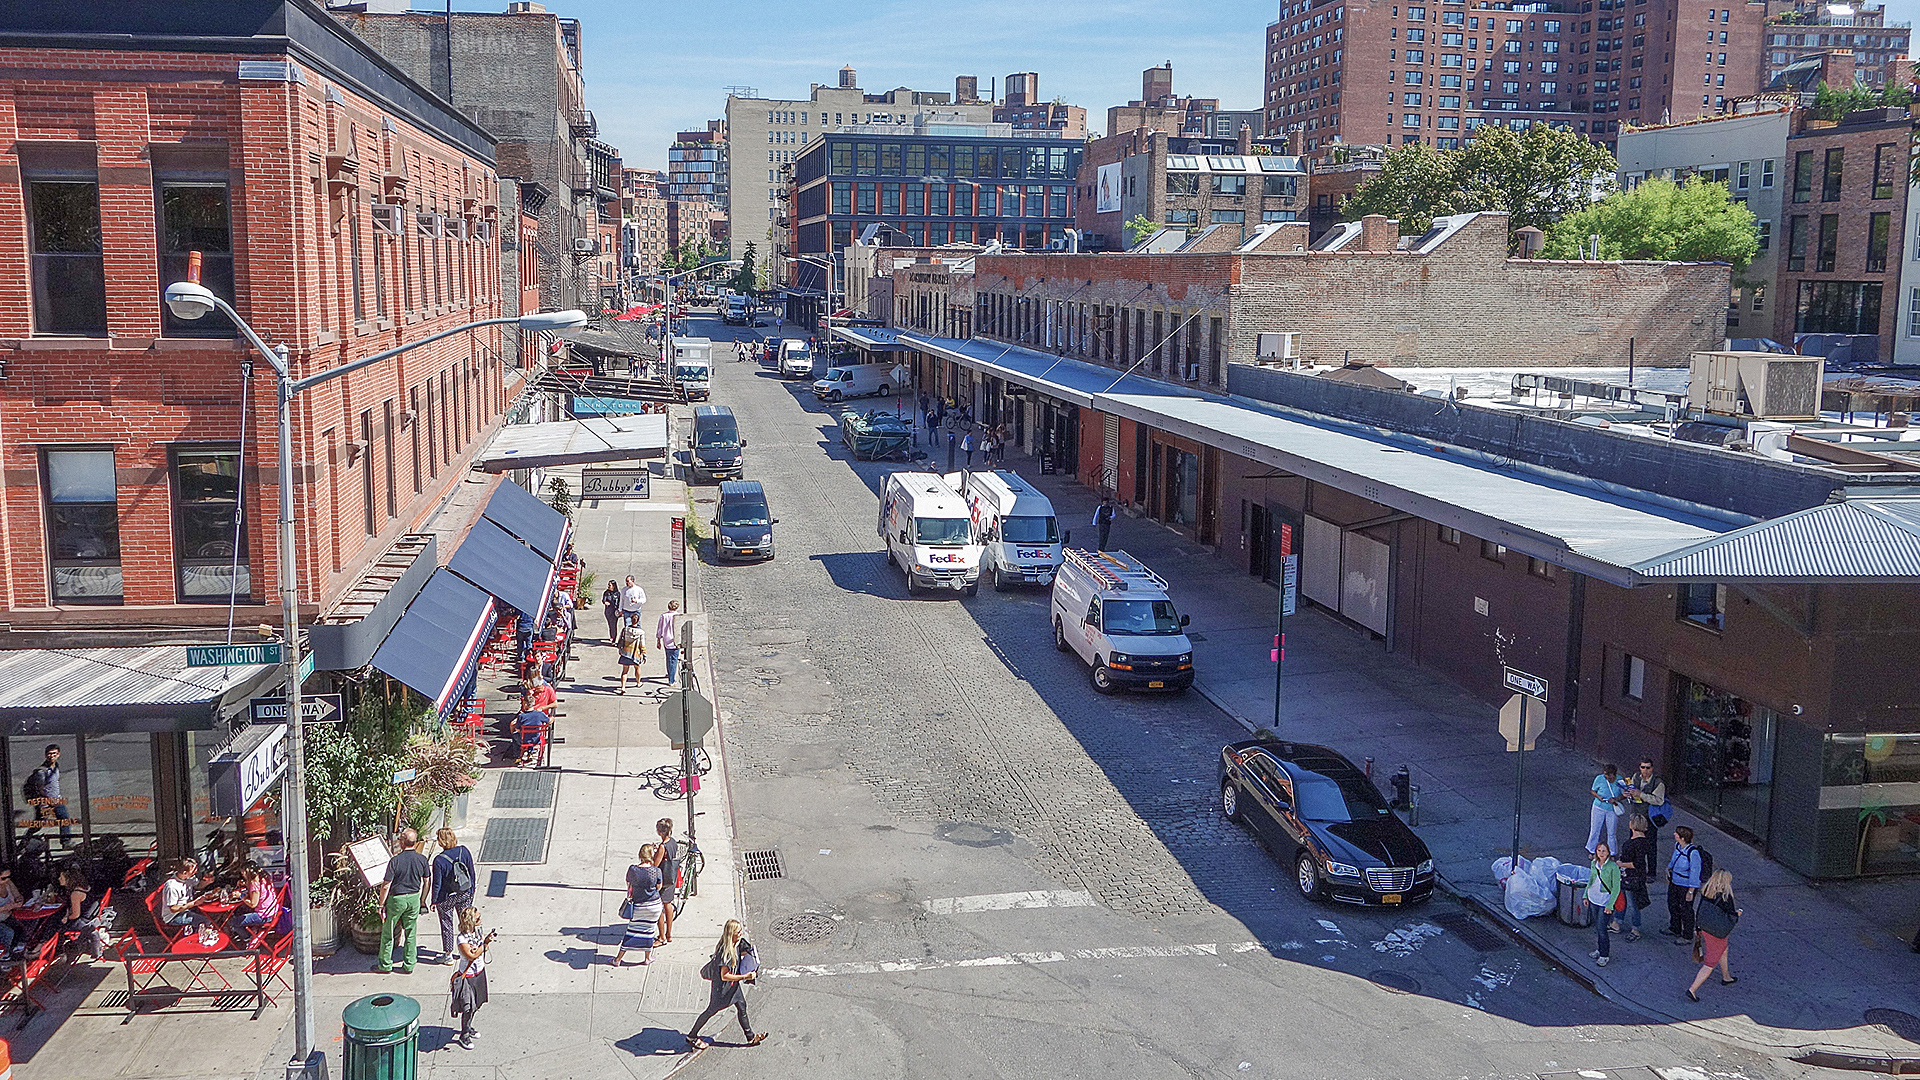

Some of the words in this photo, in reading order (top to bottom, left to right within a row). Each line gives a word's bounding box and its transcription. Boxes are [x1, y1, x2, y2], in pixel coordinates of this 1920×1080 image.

[585, 478, 631, 493] Bubby's
[929, 554, 965, 563] FedEx
[1016, 550, 1052, 559] FedEx
[190, 647, 265, 665] WASHINGTON
[269, 646, 278, 655] ST
[1510, 675, 1522, 685] ONE
[1527, 681, 1541, 692] WAY
[263, 705, 287, 716] ONE
[301, 703, 327, 715] WAY
[56, 817, 79, 827] TABLE
